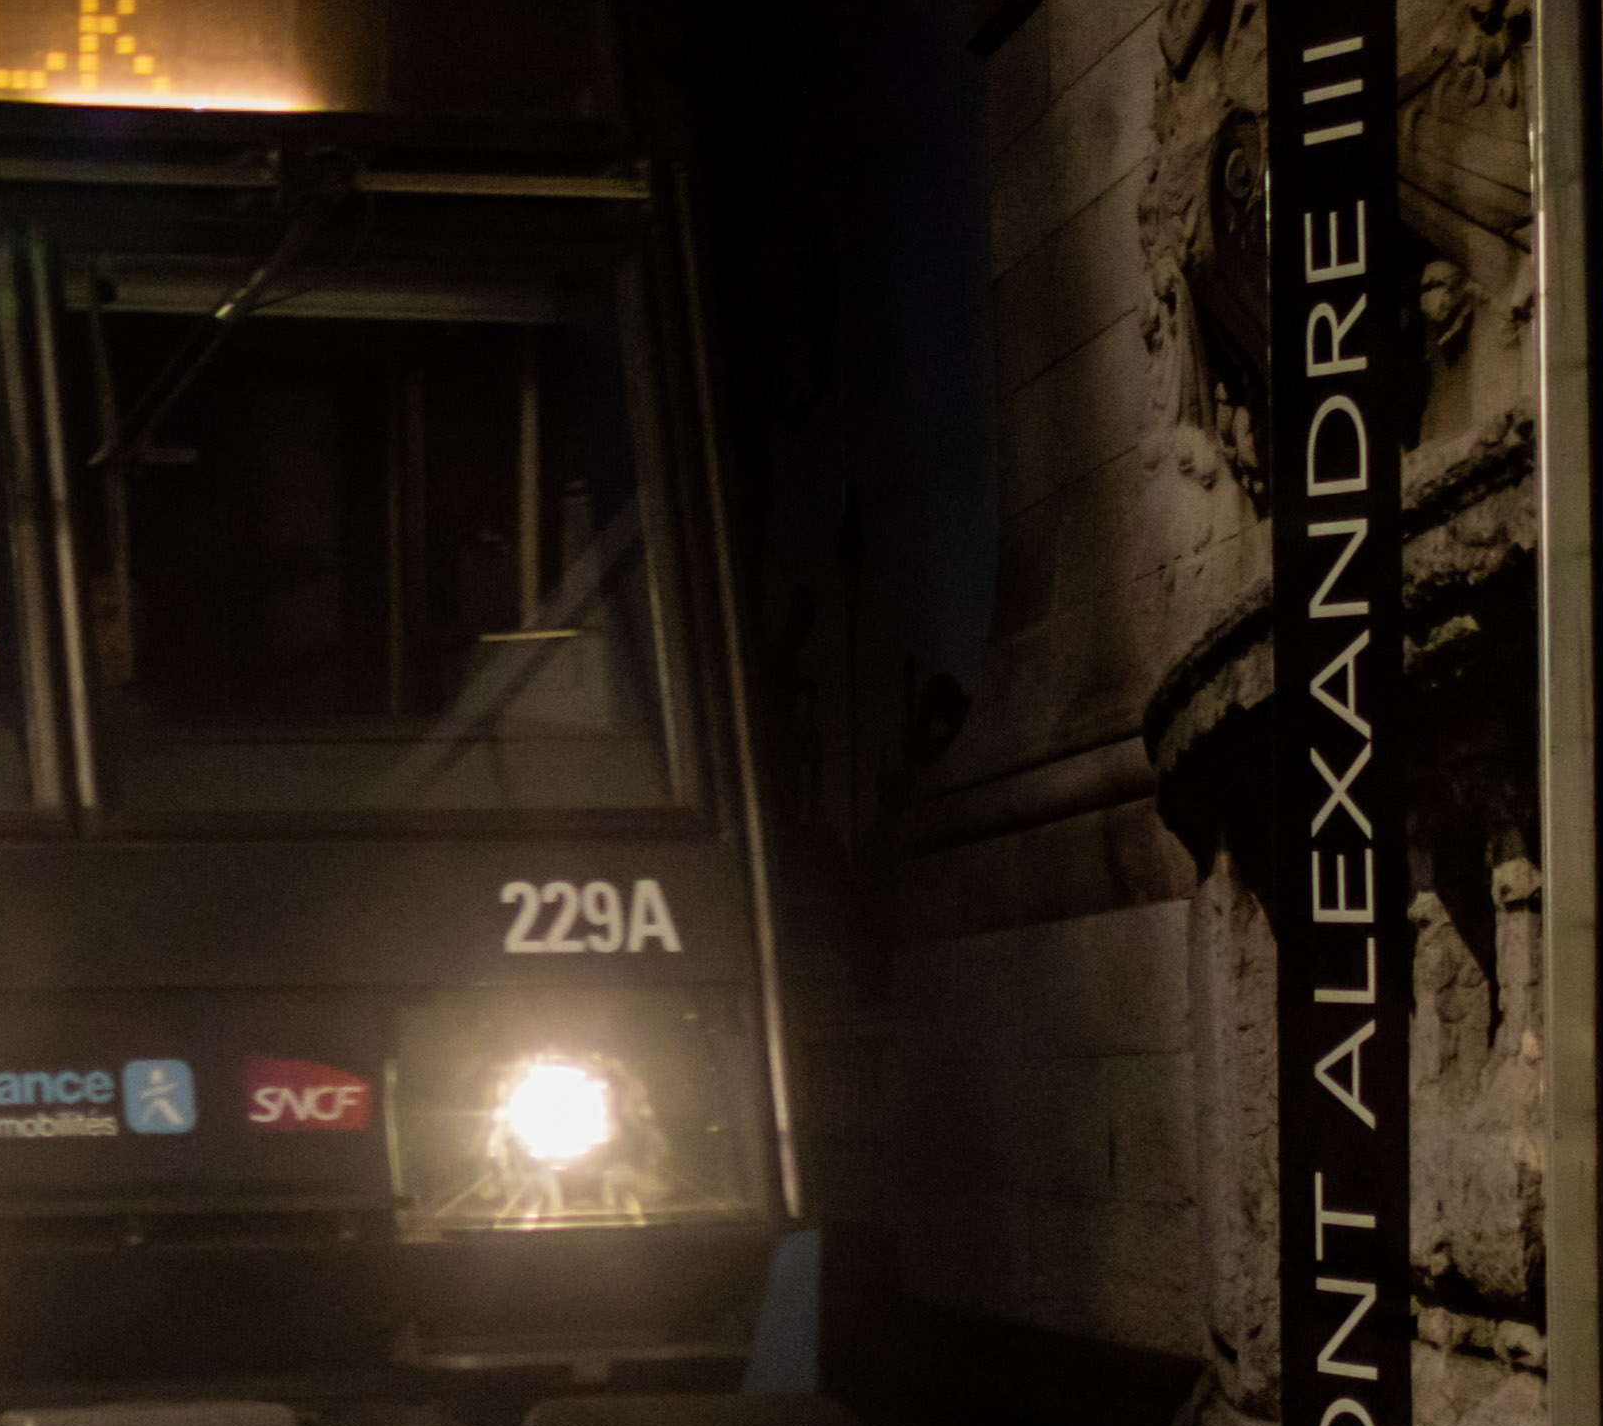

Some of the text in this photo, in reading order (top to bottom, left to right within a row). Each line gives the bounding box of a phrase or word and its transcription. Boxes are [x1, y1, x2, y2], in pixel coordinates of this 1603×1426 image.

[1302, 35, 1364, 146] III
[1302, 197, 1380, 1130] ALEXANDRE
[500, 878, 683, 954] 229A
[249, 1085, 366, 1124] SNCF
